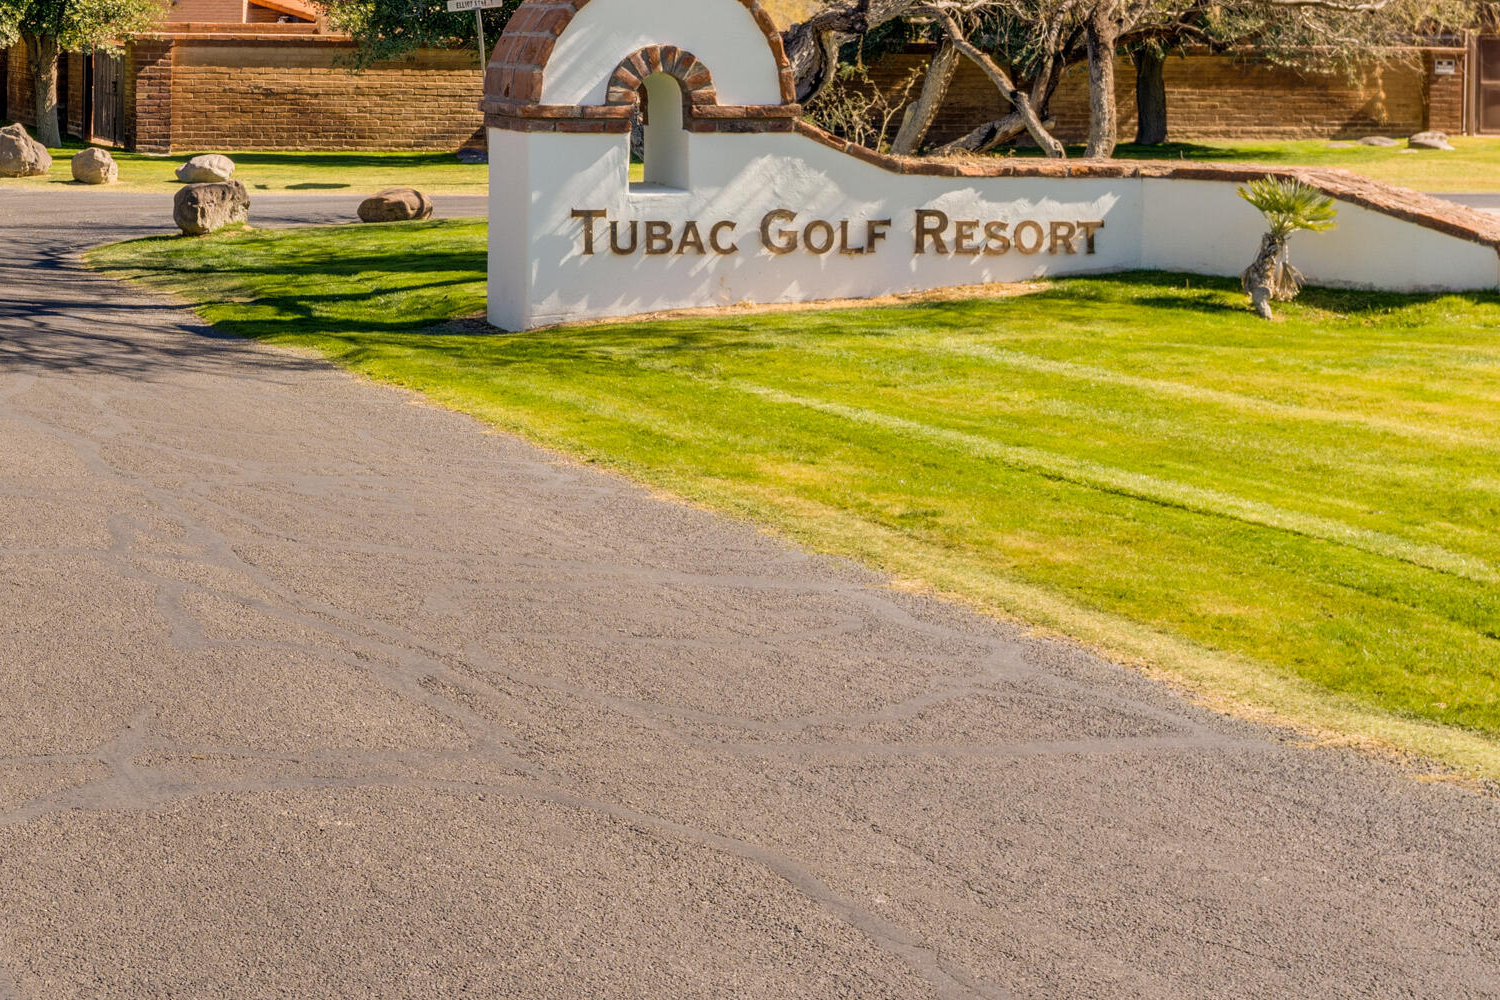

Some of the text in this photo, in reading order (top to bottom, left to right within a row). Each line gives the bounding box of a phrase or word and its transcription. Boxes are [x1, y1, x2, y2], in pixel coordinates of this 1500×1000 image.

[571, 208, 1105, 256] TUBAC GOLF RESORT
